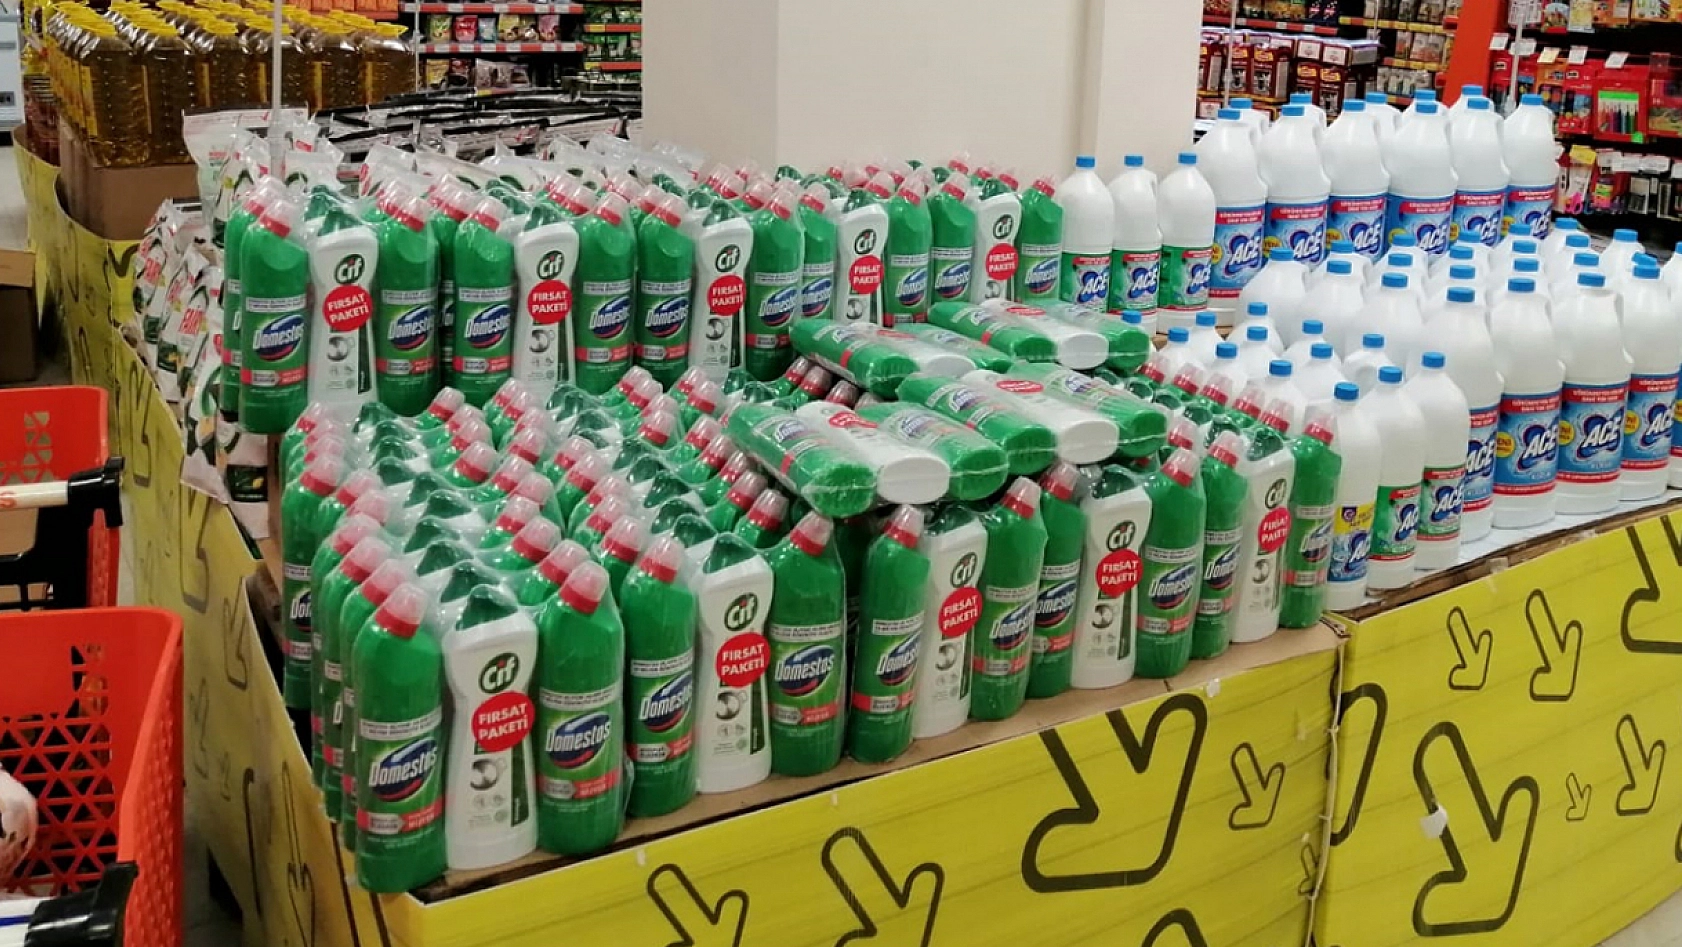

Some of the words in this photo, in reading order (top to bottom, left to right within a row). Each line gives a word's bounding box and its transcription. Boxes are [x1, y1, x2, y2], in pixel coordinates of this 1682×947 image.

[995, 218, 1012, 237] Cif
[1354, 224, 1380, 248] ACE
[1419, 225, 1447, 247] ACE
[857, 233, 876, 253] Cif
[1230, 236, 1261, 265] ACE
[1293, 232, 1321, 258] ACE
[337, 258, 363, 282] Cif
[539, 255, 563, 278] Cif
[718, 248, 740, 270] Cif
[1082, 274, 1108, 294] ACE
[1133, 268, 1158, 290] ACE
[1191, 266, 1211, 286] ACE
[328, 294, 367, 312] FIRSAT
[532, 291, 568, 303] FIRSAT
[712, 286, 743, 297] FIRSAT
[1583, 416, 1621, 448] ACE
[1646, 409, 1674, 436] ACE
[1523, 425, 1559, 458] ACE
[1466, 441, 1494, 473] ACE
[1267, 481, 1287, 506] Cif
[1436, 485, 1464, 512] ACE
[1109, 524, 1135, 549] Cif
[953, 556, 977, 584] Cif
[1103, 560, 1139, 573] FIRSAT
[727, 600, 756, 628] Cif
[944, 595, 978, 616] FIRSAT
[722, 643, 765, 661] FIRSAT
[481, 657, 516, 691] Cif
[775, 654, 834, 682] Domestos
[478, 702, 528, 725] FIRSAT
[478, 717, 529, 741] PAKETİ
[545, 718, 612, 753] Domestos
[368, 744, 438, 788] Domestos
